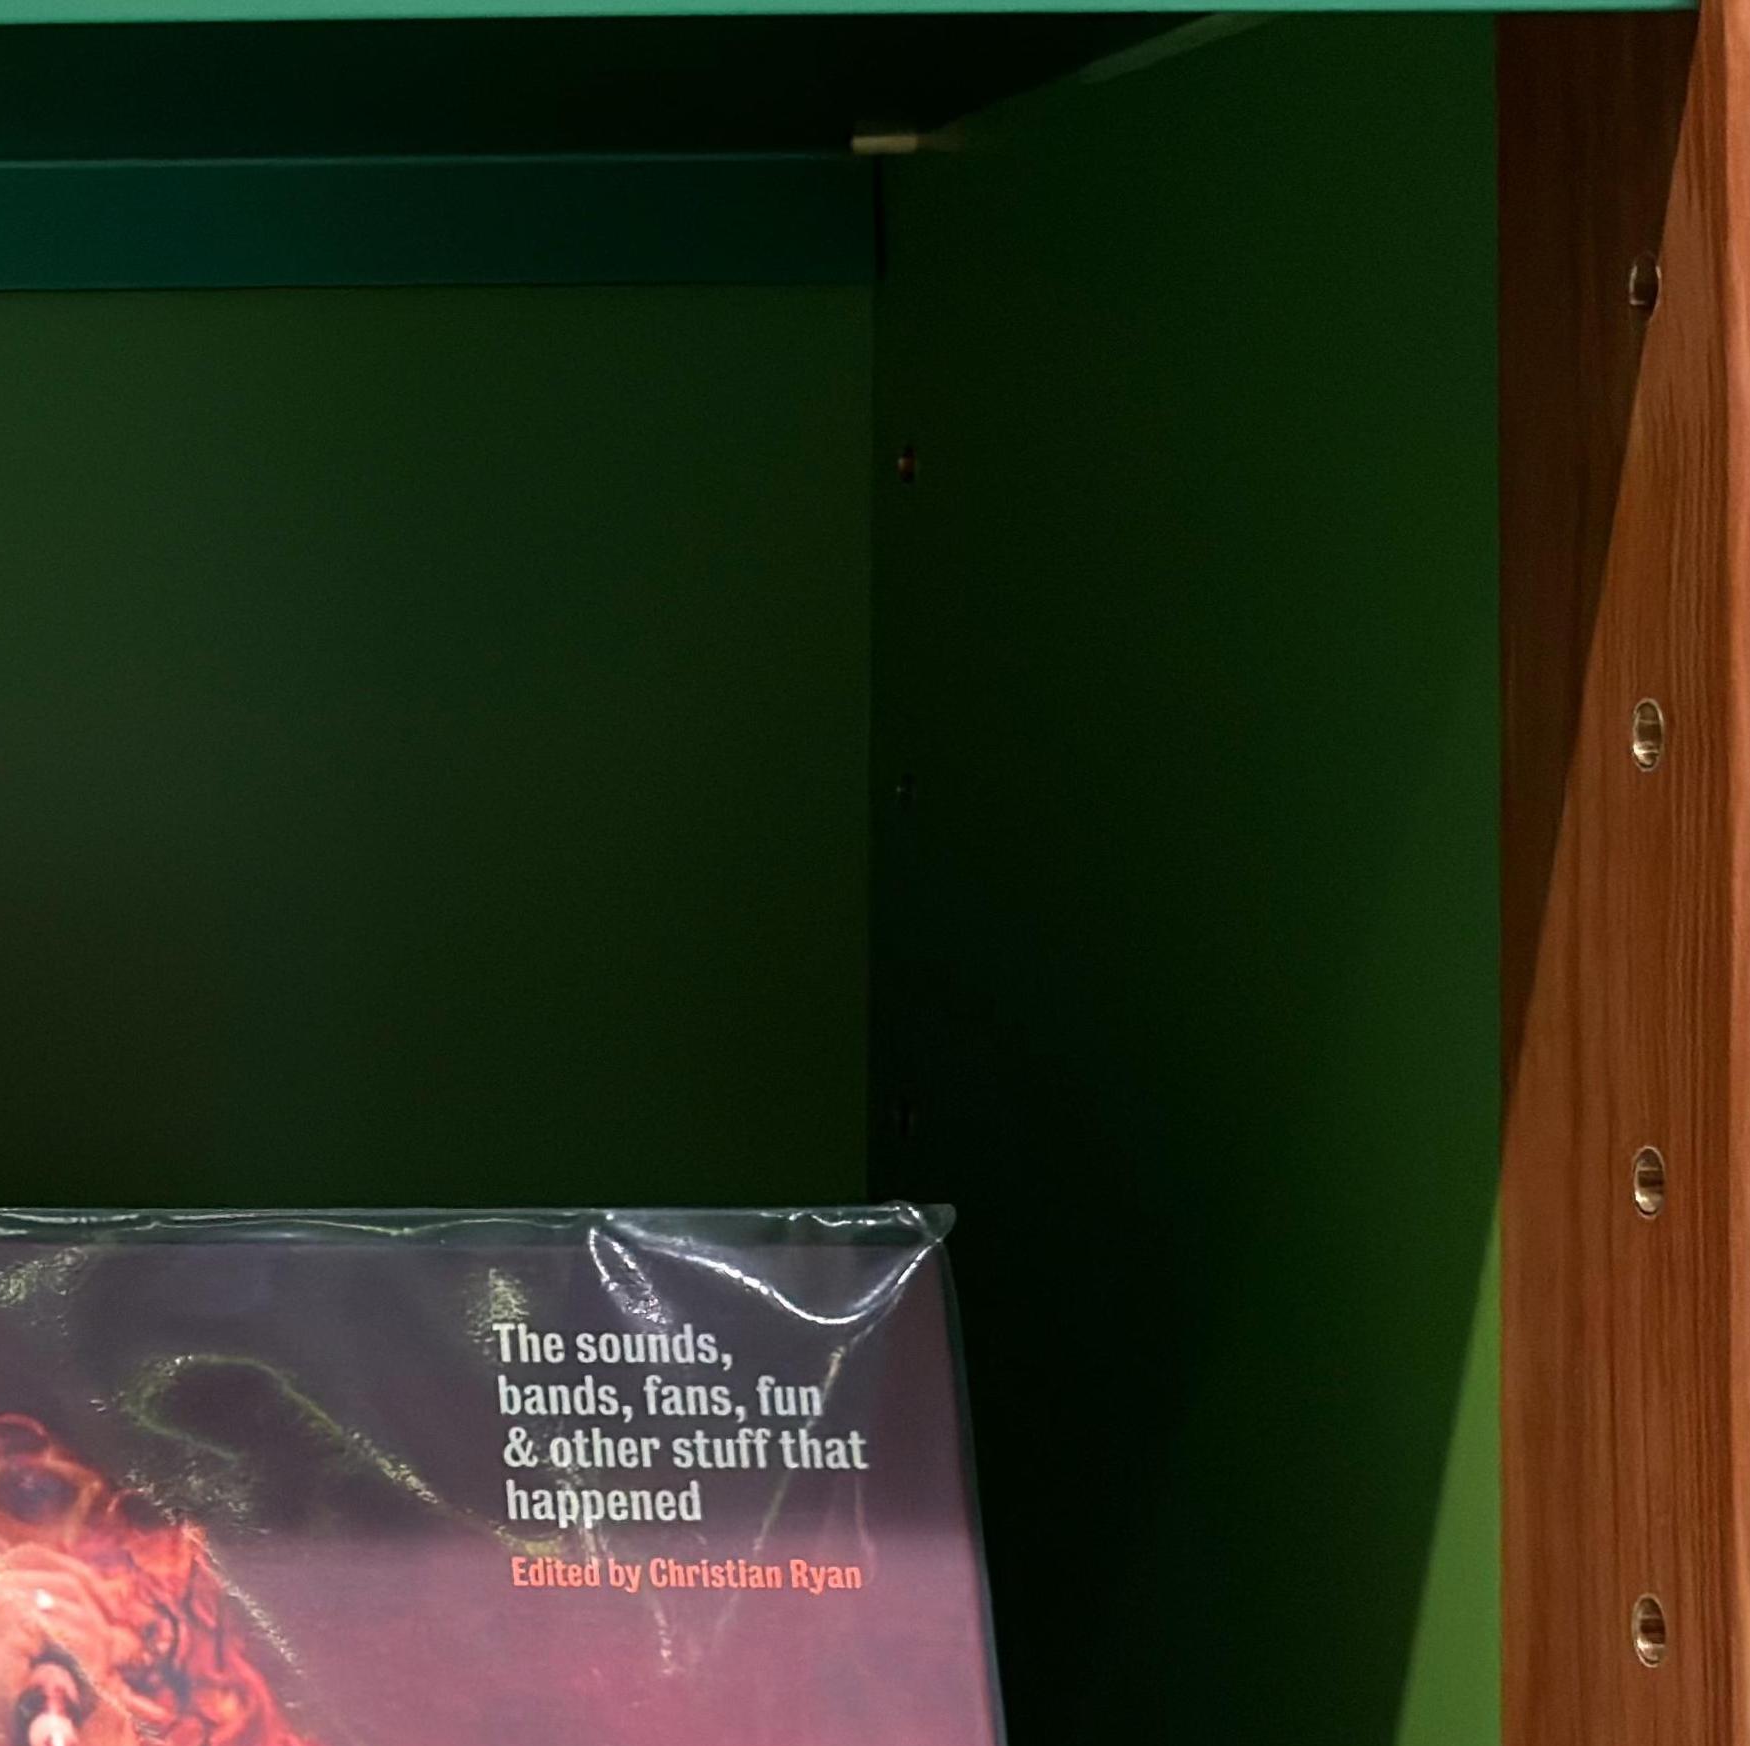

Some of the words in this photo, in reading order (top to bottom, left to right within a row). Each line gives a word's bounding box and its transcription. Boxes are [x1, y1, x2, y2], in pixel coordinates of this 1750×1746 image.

[492, 1323, 564, 1364] The
[576, 1323, 733, 1370] sounds,
[498, 1375, 632, 1422] bands,
[643, 1375, 746, 1423] fans,
[756, 1376, 823, 1417] fun
[503, 1427, 539, 1469] &
[549, 1427, 661, 1470] other
[672, 1429, 769, 1470] stuff
[778, 1430, 869, 1470] that
[506, 1479, 702, 1529] happened
[512, 1556, 601, 1588] Edited
[607, 1556, 641, 1593] by
[649, 1558, 782, 1590] Christian
[790, 1559, 862, 1596] Ryan
